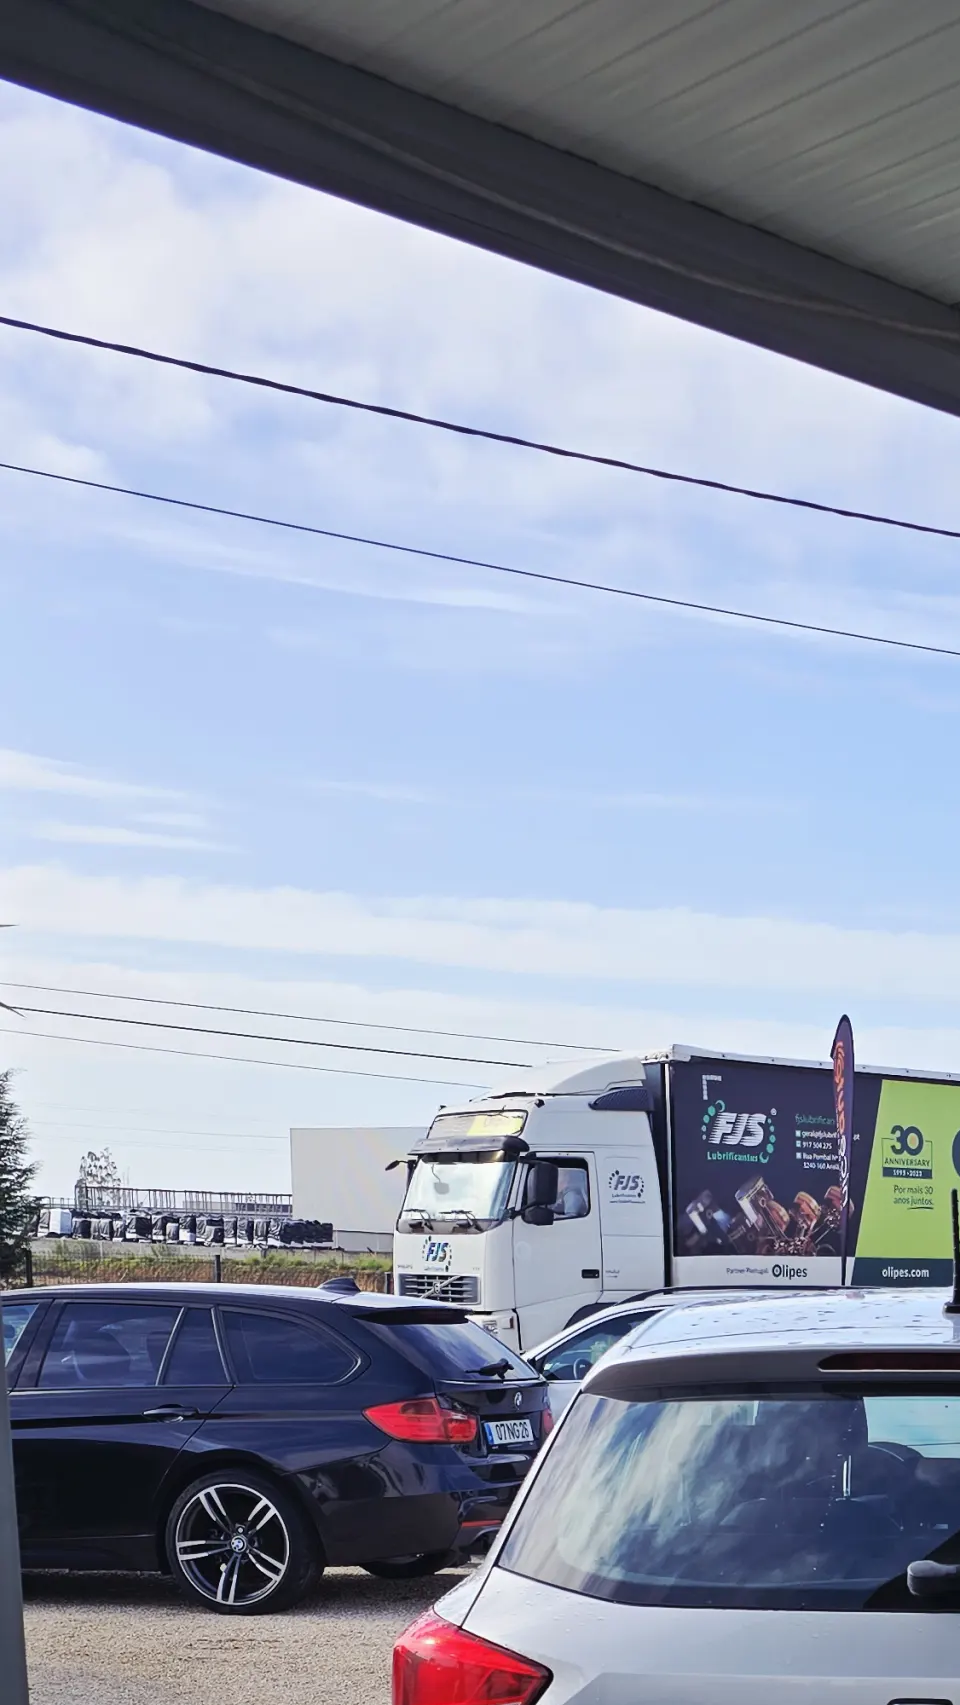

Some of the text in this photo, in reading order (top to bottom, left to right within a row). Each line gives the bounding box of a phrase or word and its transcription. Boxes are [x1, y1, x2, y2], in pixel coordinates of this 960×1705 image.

[708, 1112, 767, 1147] FJS
[890, 1125, 924, 1156] 30
[884, 1157, 931, 1167] ANNIVERSARY
[614, 1175, 640, 1191] FJS
[893, 1184, 934, 1195] Por mais 30
[426, 1242, 449, 1262] FJS
[771, 1264, 808, 1280] Olipes
[881, 1267, 930, 1280] olipes.com
